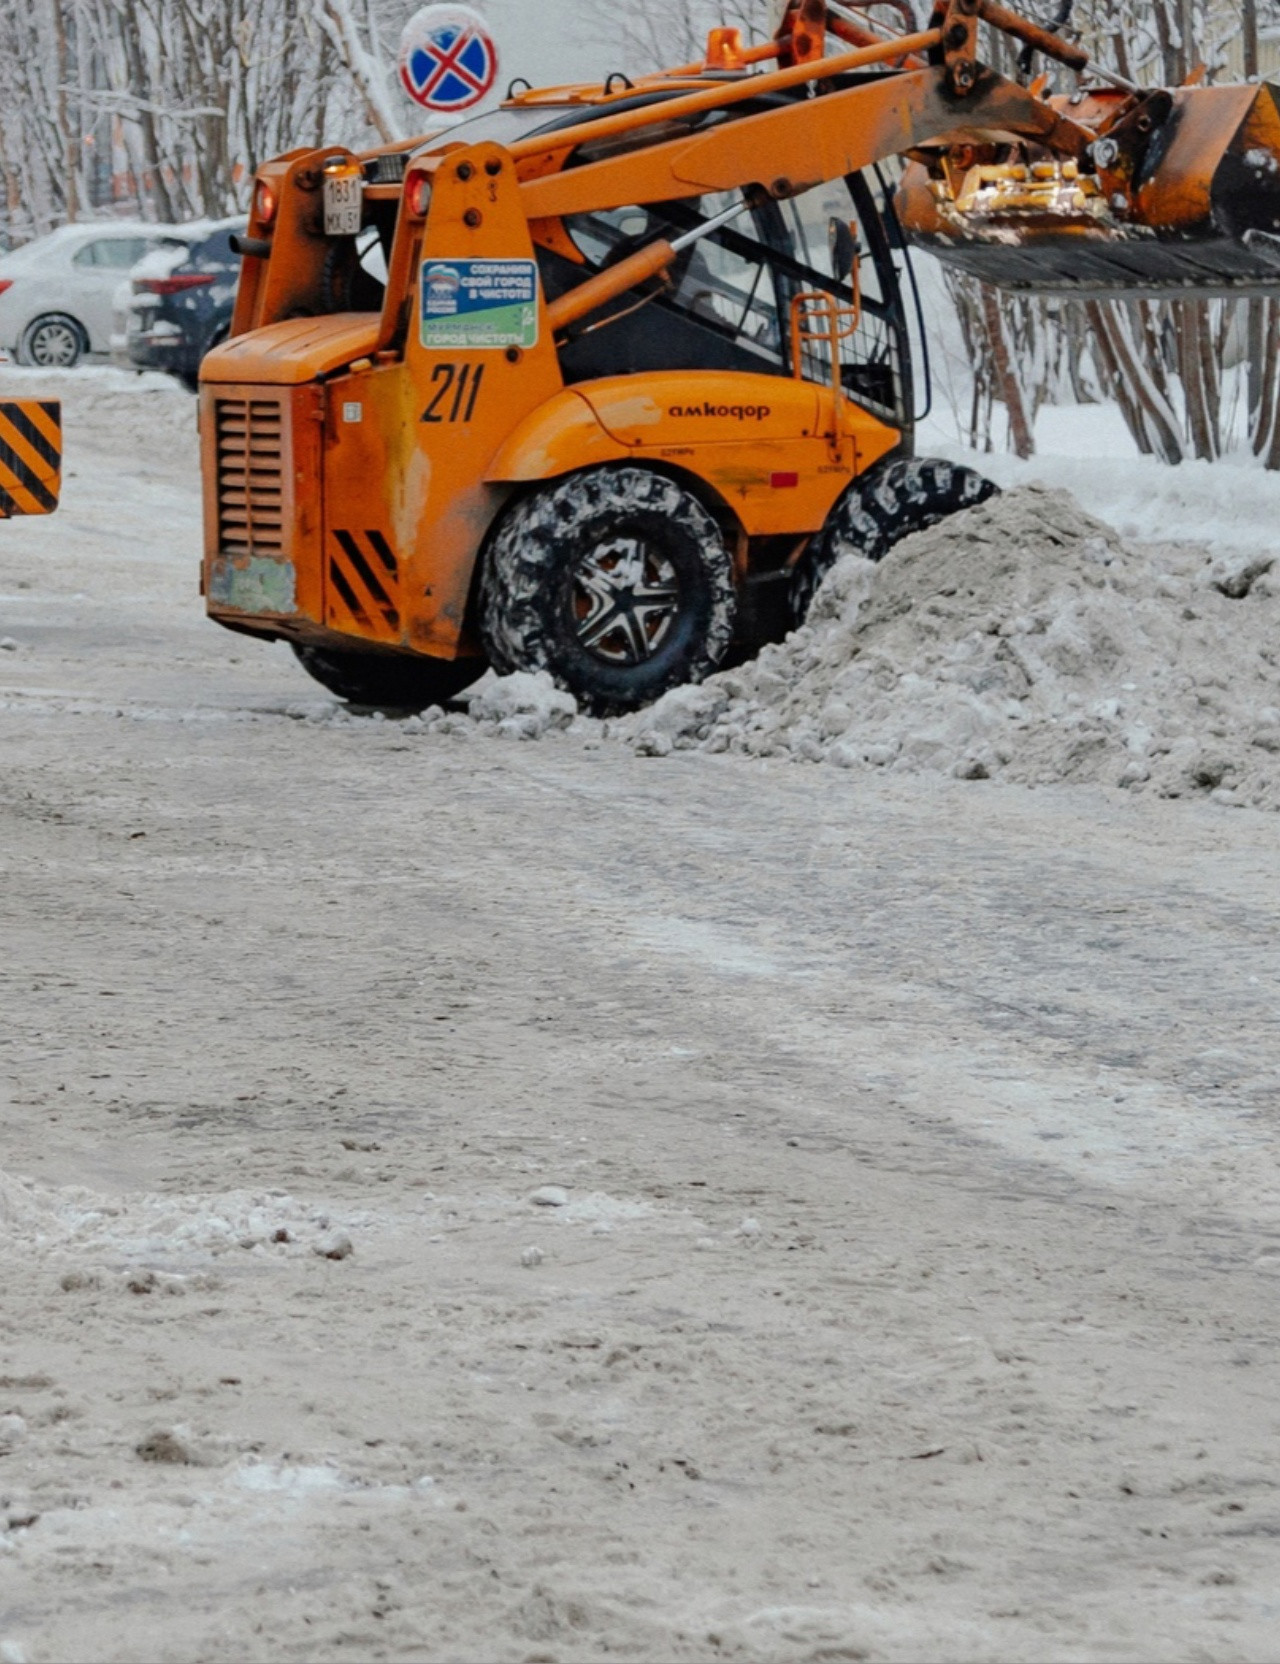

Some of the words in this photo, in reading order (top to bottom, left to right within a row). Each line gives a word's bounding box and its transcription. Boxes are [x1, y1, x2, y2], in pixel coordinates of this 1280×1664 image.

[460, 275, 492, 287] СВОЙ
[493, 276, 532, 288] ГОРОД
[469, 288, 478, 299] В
[426, 334, 468, 345] ГОРОД
[468, 334, 525, 344] ЧИСТОТЫ
[420, 364, 485, 422] 211
